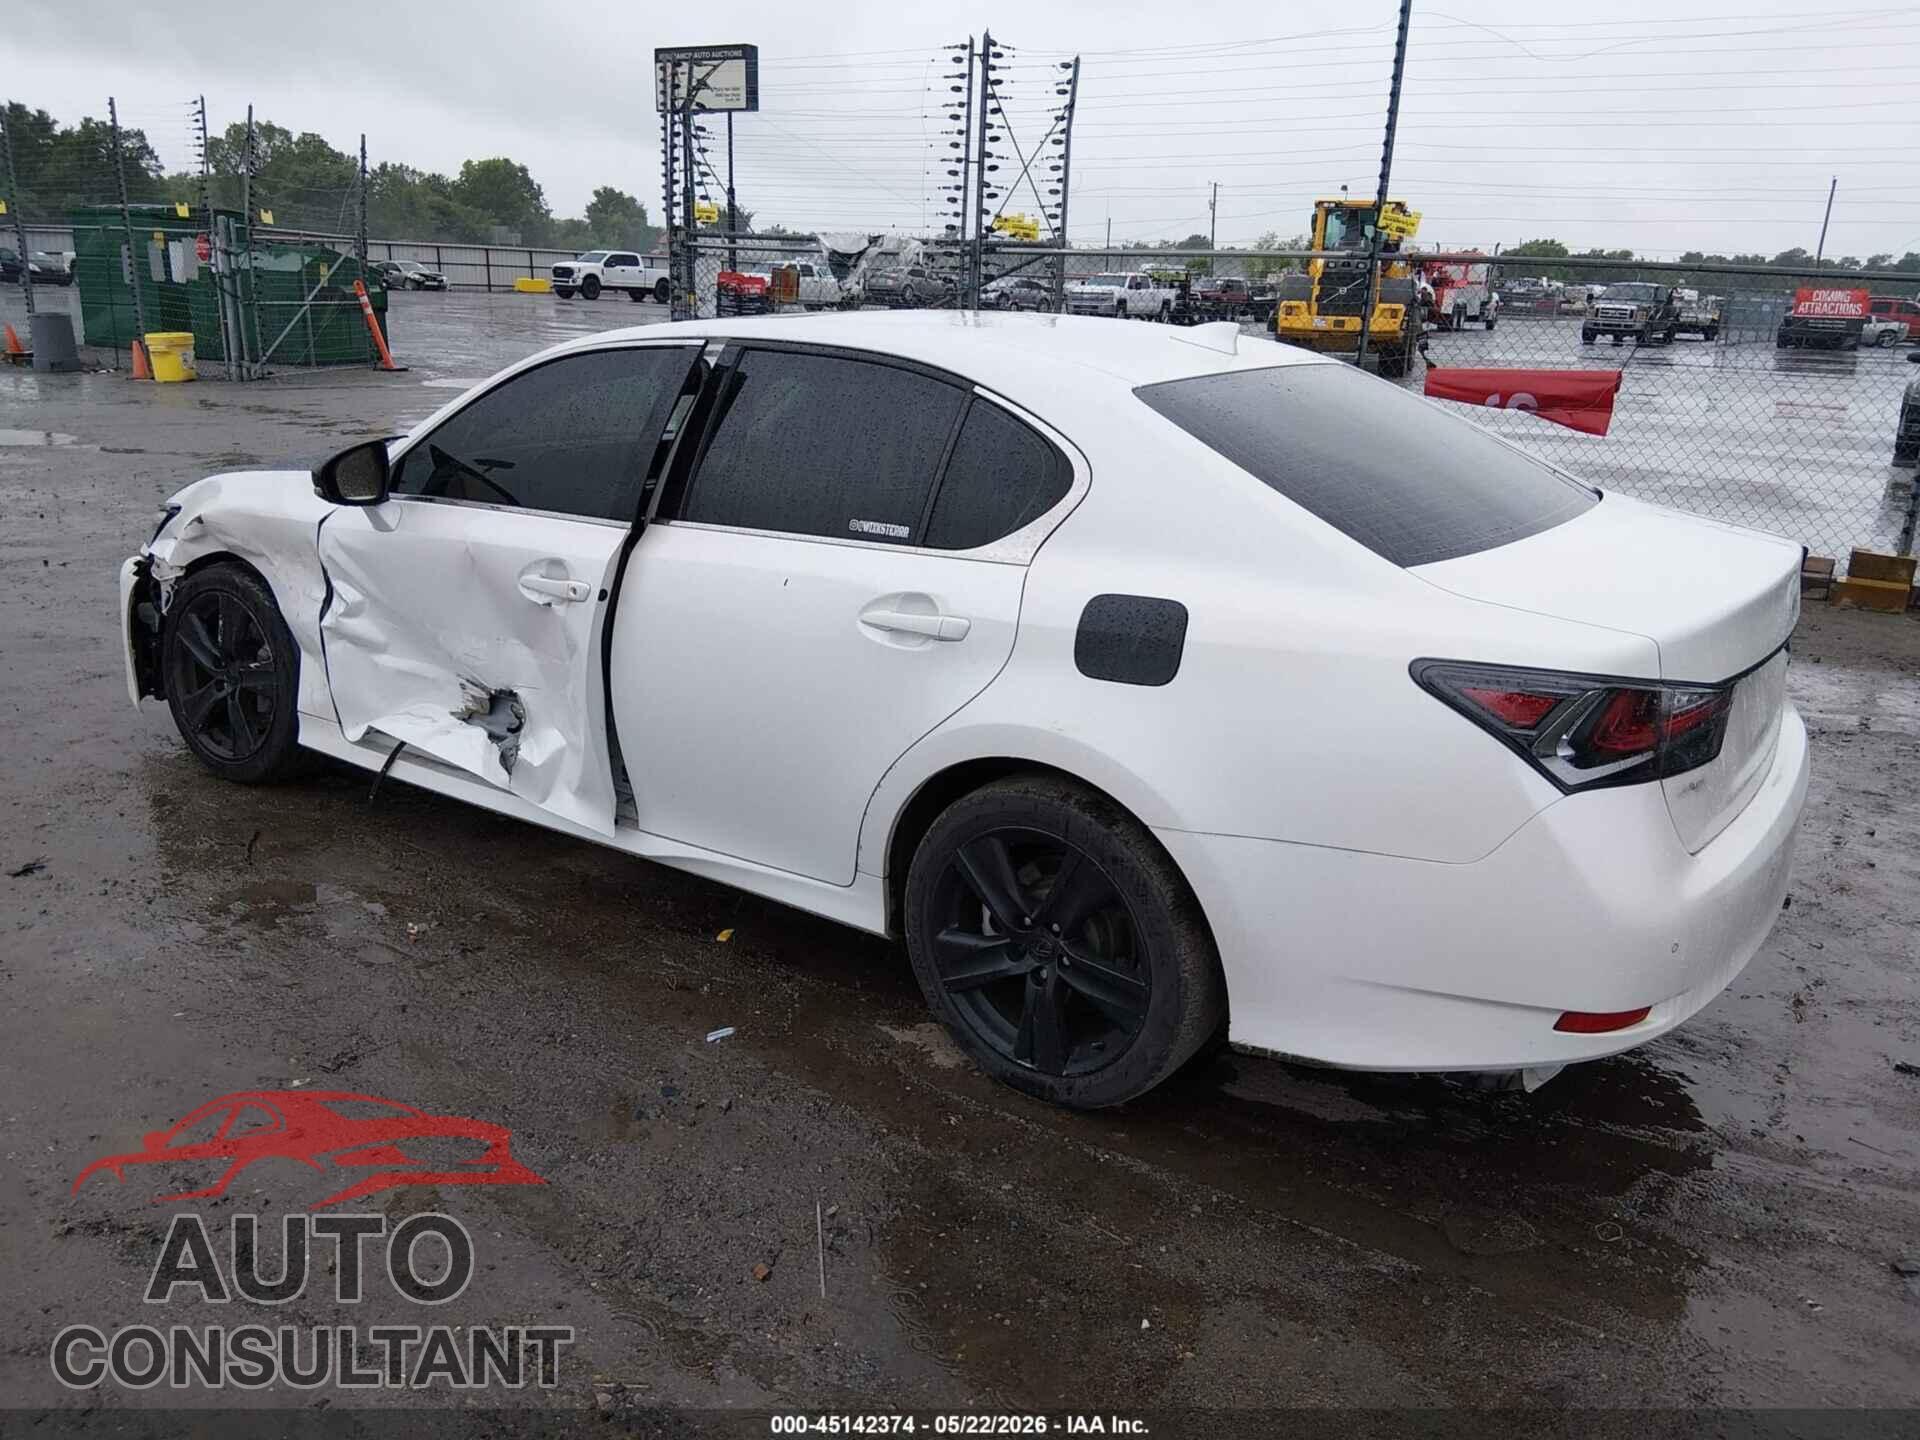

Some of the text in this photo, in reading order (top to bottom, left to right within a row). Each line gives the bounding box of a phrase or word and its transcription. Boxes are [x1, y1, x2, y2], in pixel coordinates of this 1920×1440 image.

[712, 49, 742, 57] AUCTIONS
[1812, 290, 1851, 302] COMING
[1798, 302, 1863, 315] ATTRACTIONS
